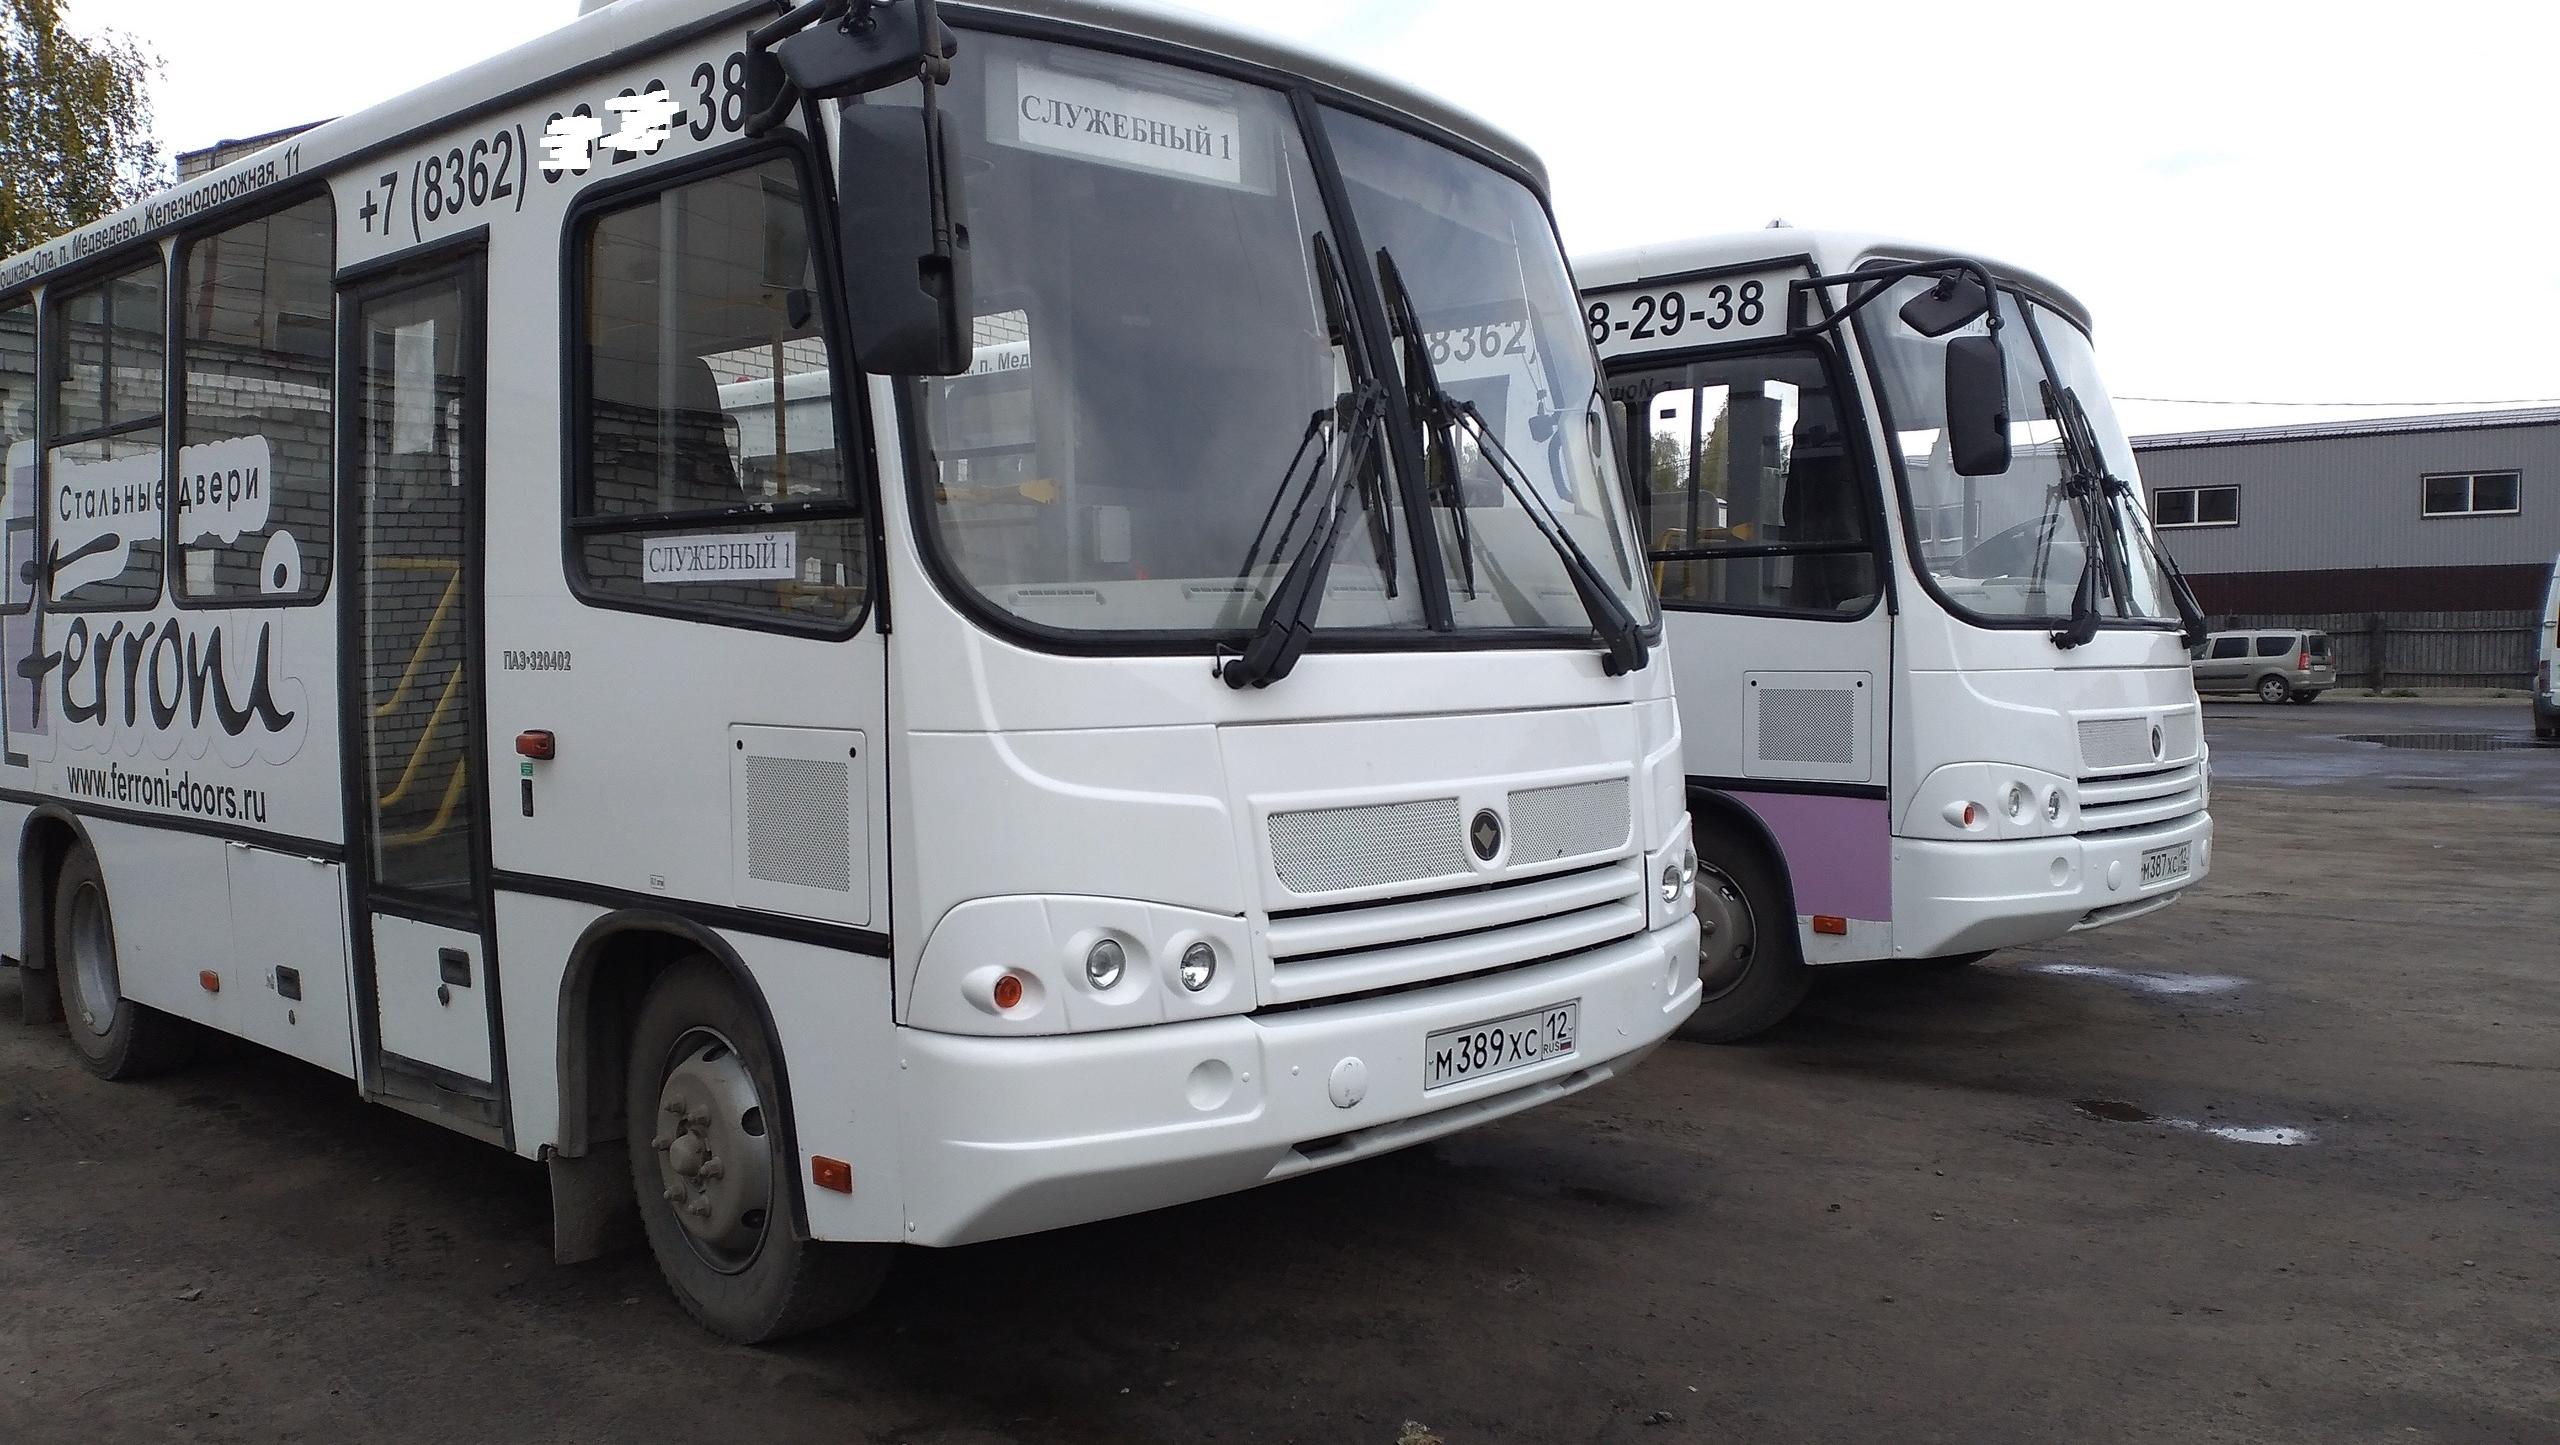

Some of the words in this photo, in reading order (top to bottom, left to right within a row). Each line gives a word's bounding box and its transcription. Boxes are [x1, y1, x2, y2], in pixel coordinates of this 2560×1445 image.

[1020, 94, 1213, 157] СЛУЖЕБНЫЙ
[1220, 134, 1232, 161] 1
[59, 245, 69, 266] п.
[72, 218, 141, 259] Медведево,
[284, 142, 301, 177] 11
[358, 170, 399, 236] +7
[410, 124, 528, 243] (8362)
[1588, 280, 1764, 345] 8-29-38
[59, 479, 164, 521] Стальные
[649, 535, 777, 574] СЛУЖЕБНЫЙ
[783, 542, 791, 569] 1
[66, 762, 267, 823] www.ferroni-doors.ru
[1543, 1041, 1560, 1055] RUS
[1546, 1011, 1568, 1041] 12
